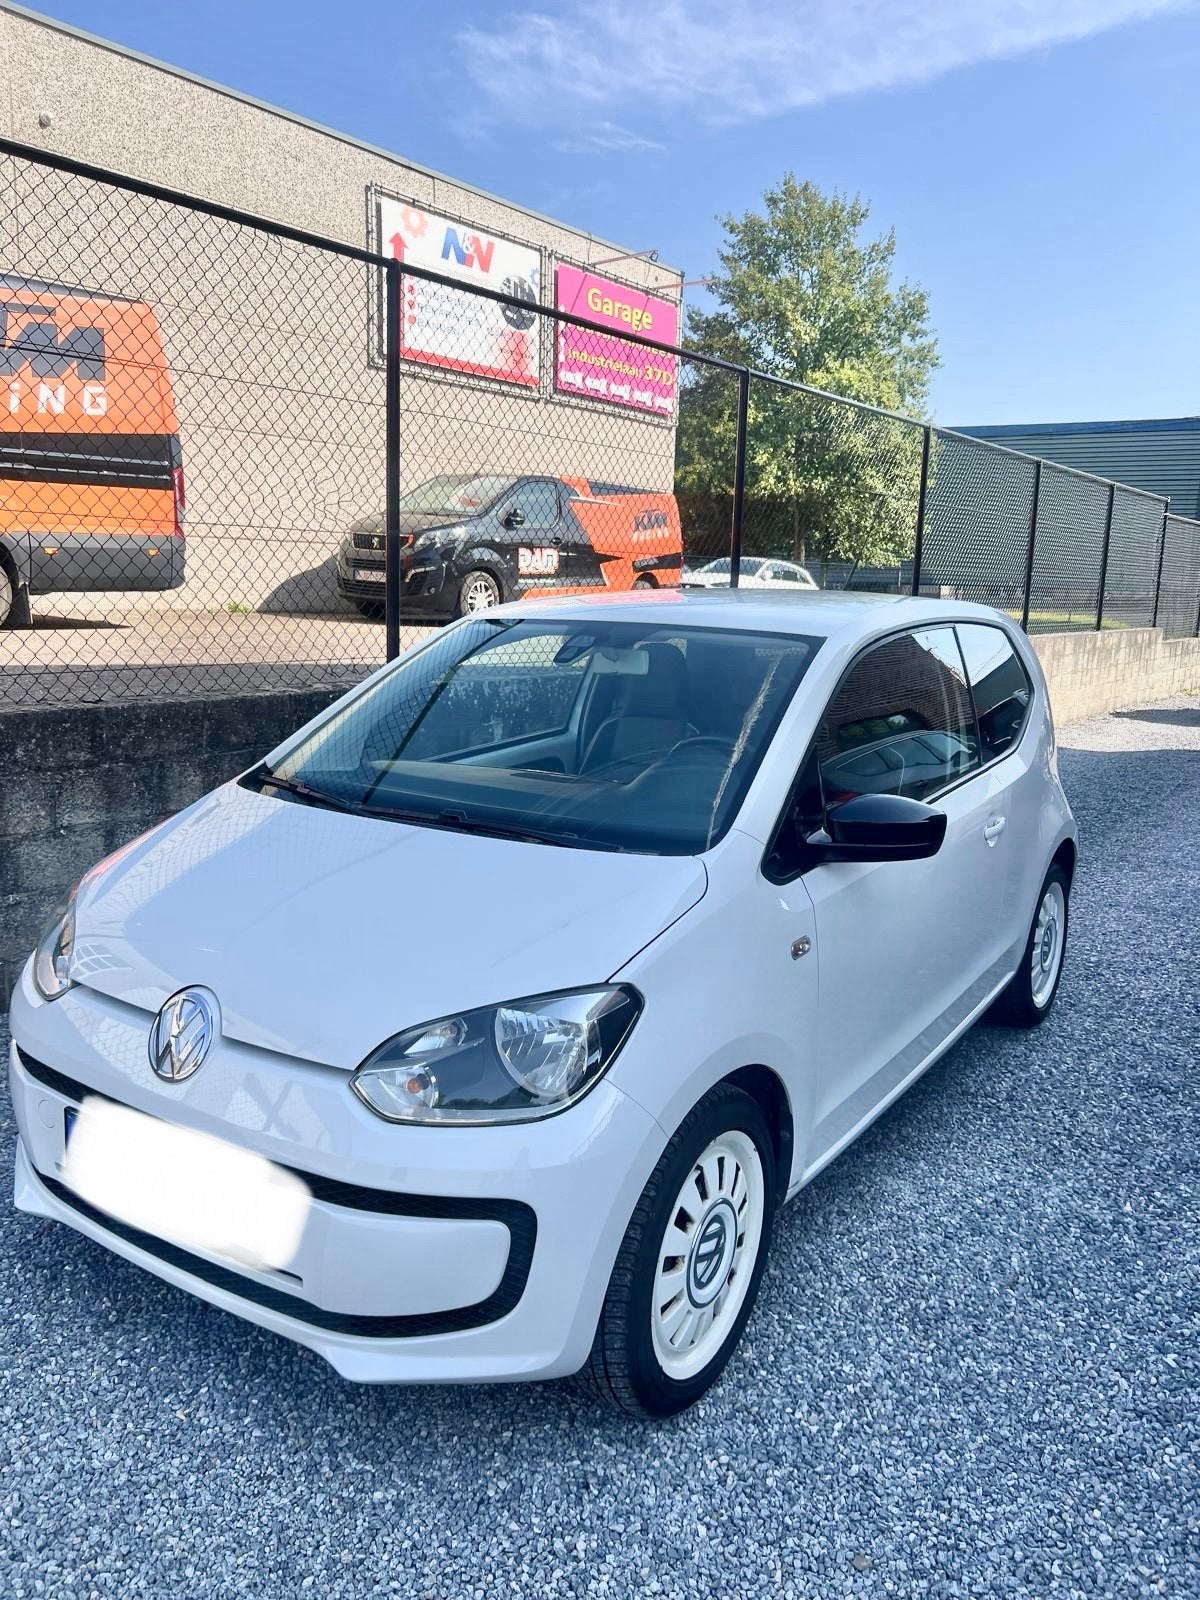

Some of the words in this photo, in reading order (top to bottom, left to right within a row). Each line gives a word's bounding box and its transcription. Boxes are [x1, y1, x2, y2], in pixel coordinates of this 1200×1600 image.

[441, 227, 494, 273] N&N
[586, 287, 654, 332] Garage
[644, 364, 673, 386] 37D
